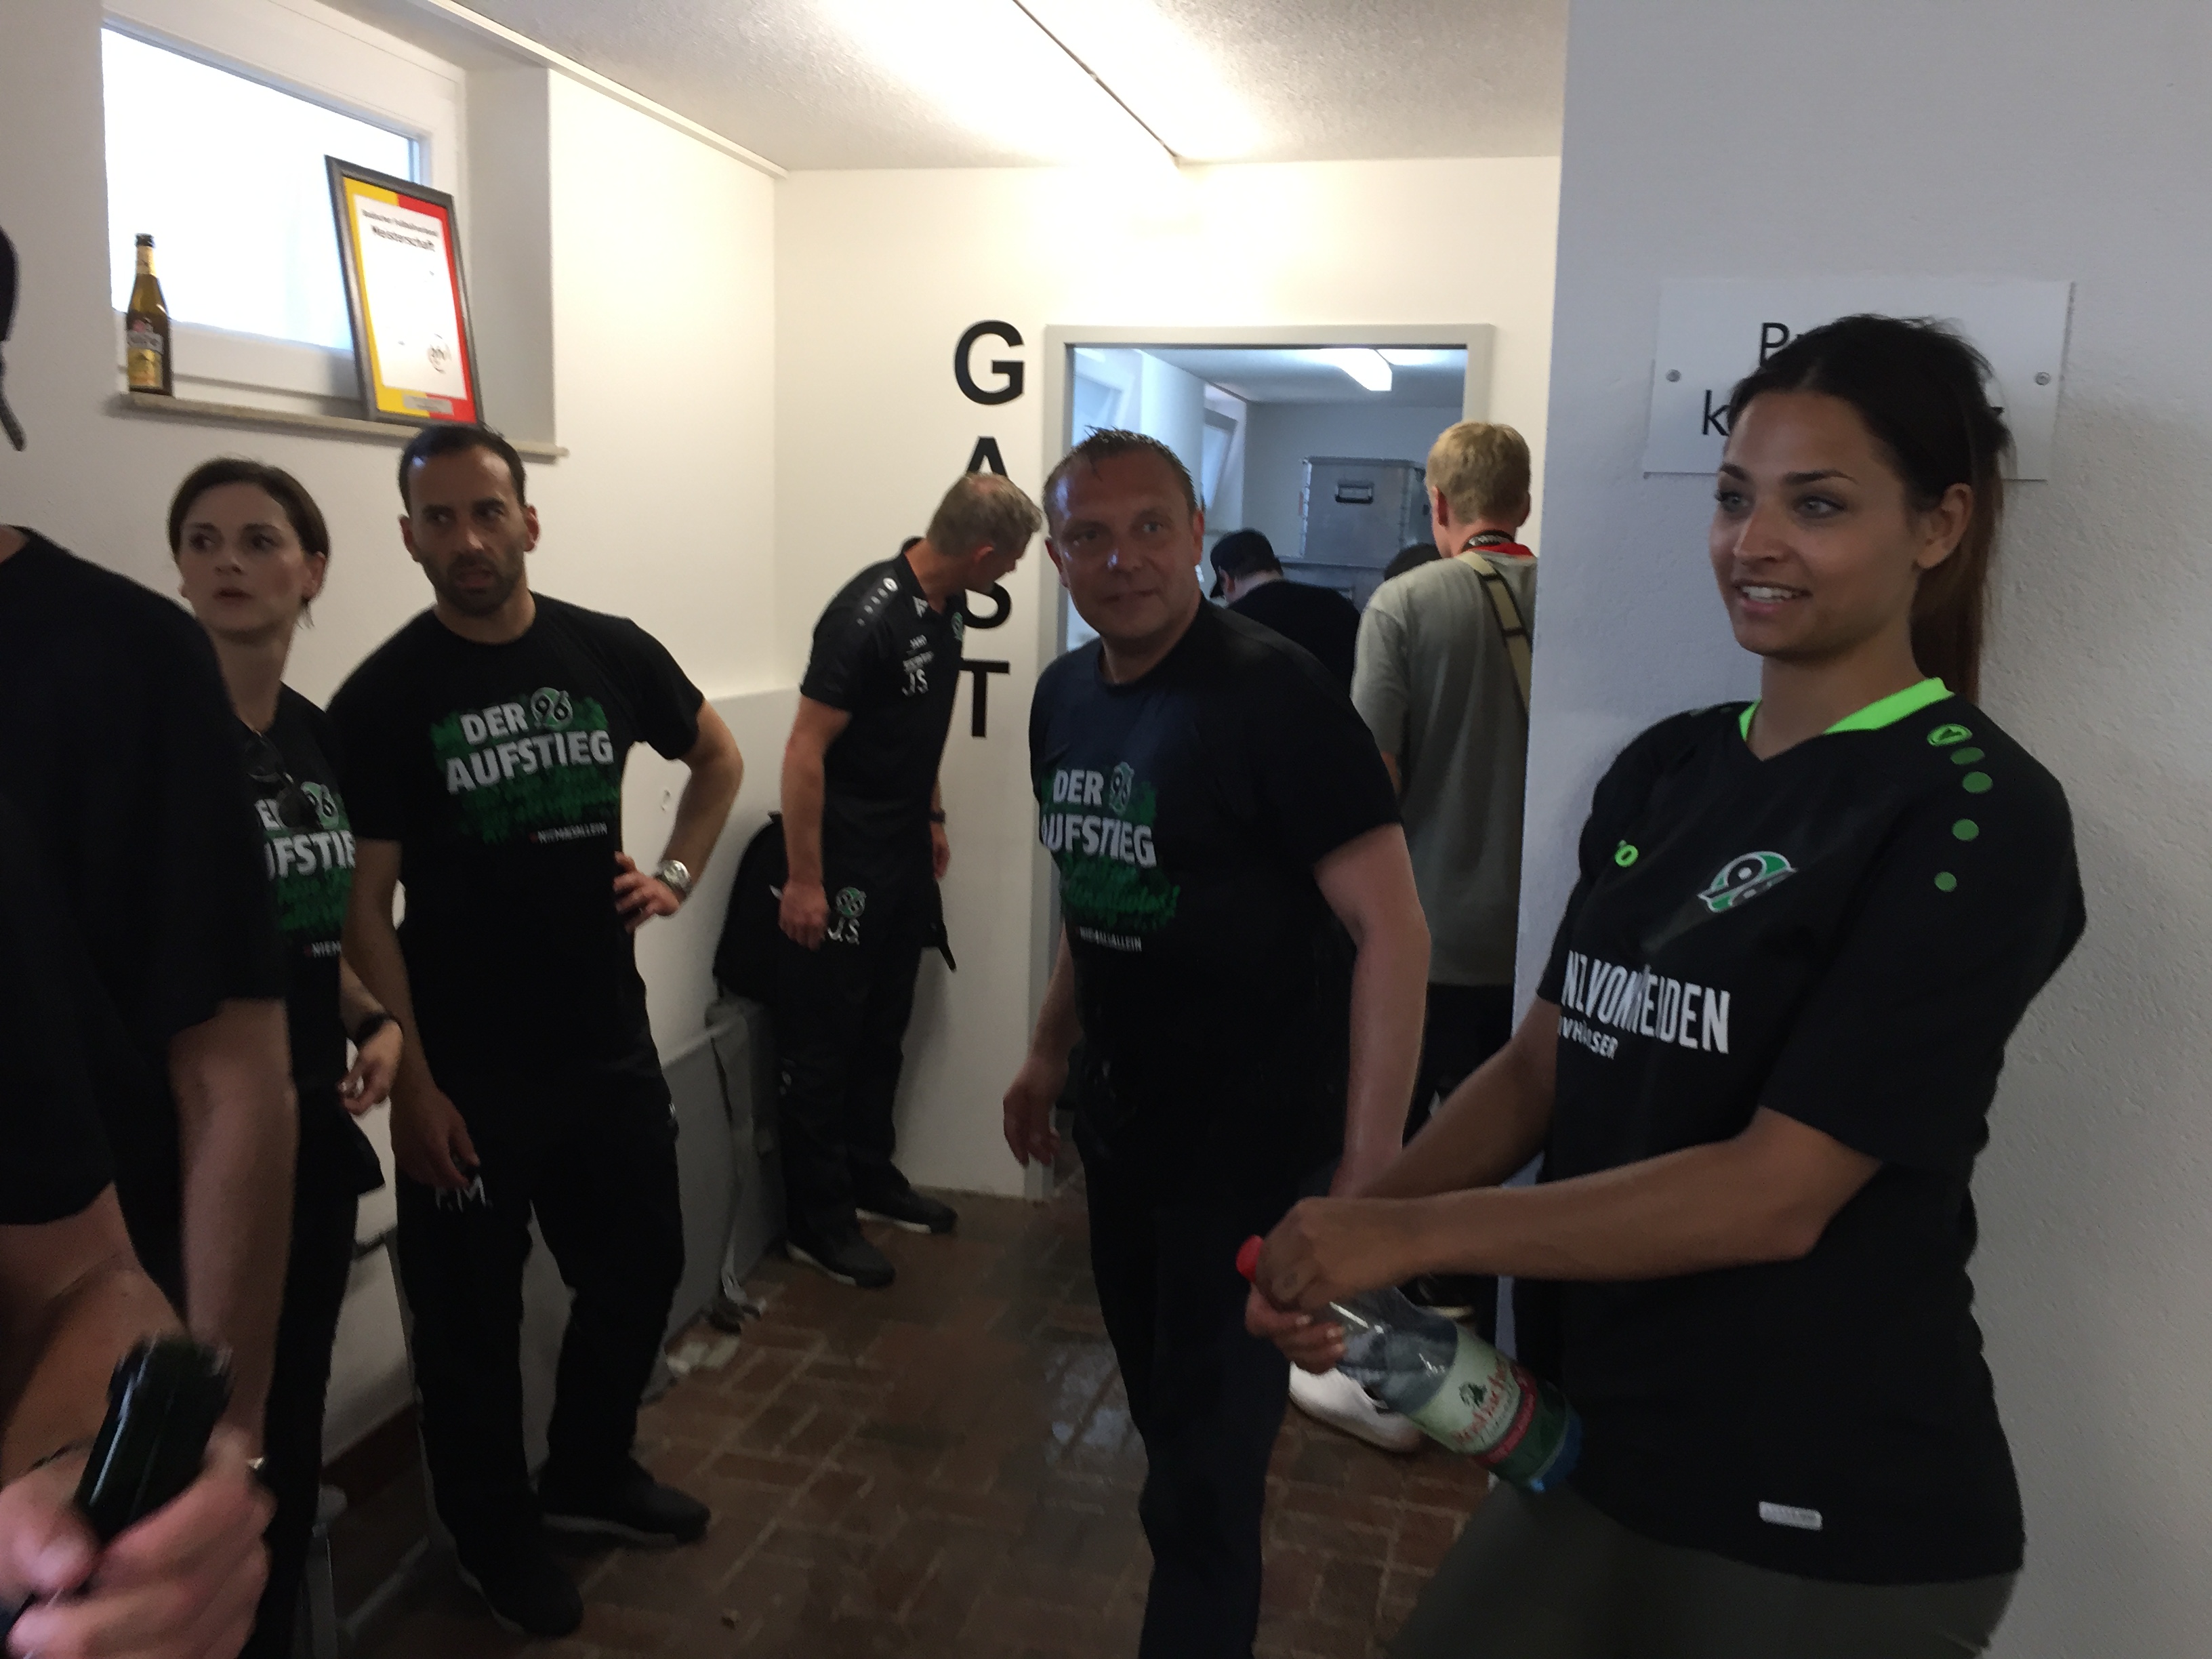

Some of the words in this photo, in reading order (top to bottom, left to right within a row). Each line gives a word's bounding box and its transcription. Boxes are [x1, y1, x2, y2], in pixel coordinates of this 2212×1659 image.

[460, 702, 529, 745] DER
[446, 729, 615, 795] AUFSTIEG
[1052, 769, 1104, 807] DER
